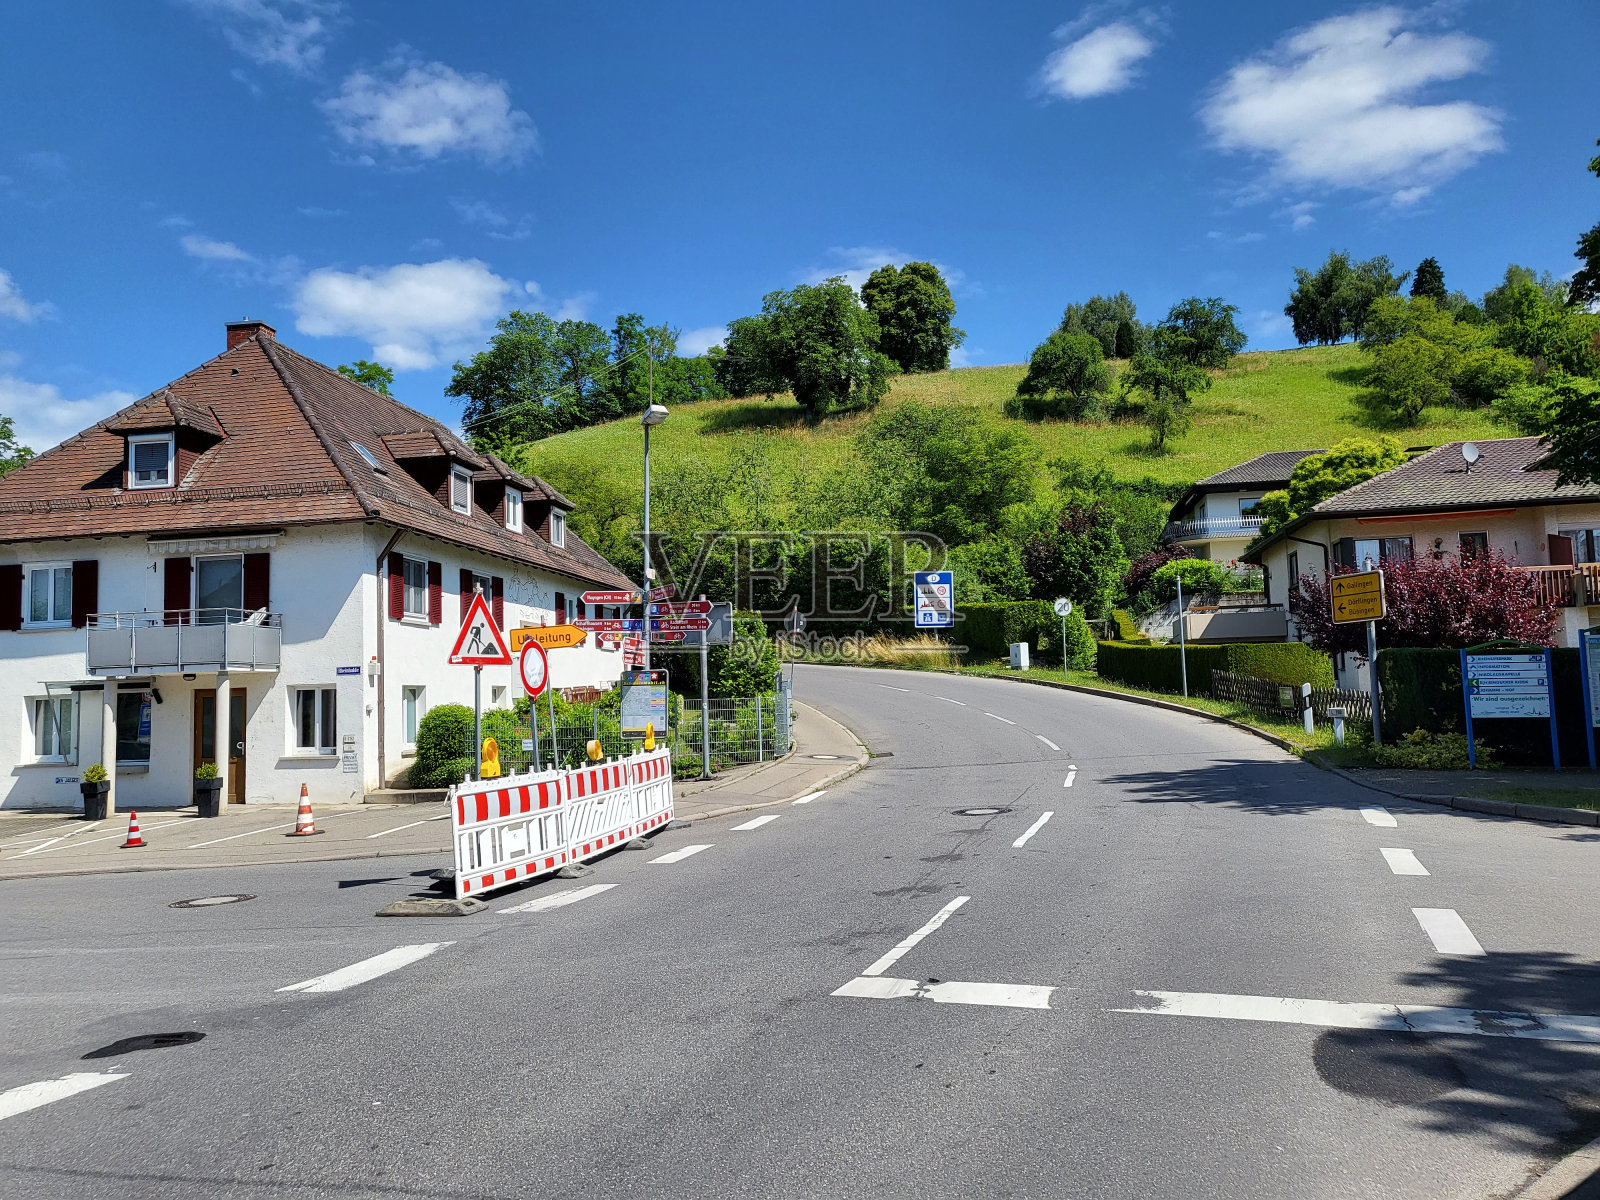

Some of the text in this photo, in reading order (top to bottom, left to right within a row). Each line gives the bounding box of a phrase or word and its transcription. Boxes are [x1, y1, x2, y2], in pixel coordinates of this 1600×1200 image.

[1346, 580, 1373, 589] Gailingen
[1058, 602, 1070, 612] 20
[1348, 607, 1375, 616] Büsingen
[518, 633, 571, 645] Uleitung
